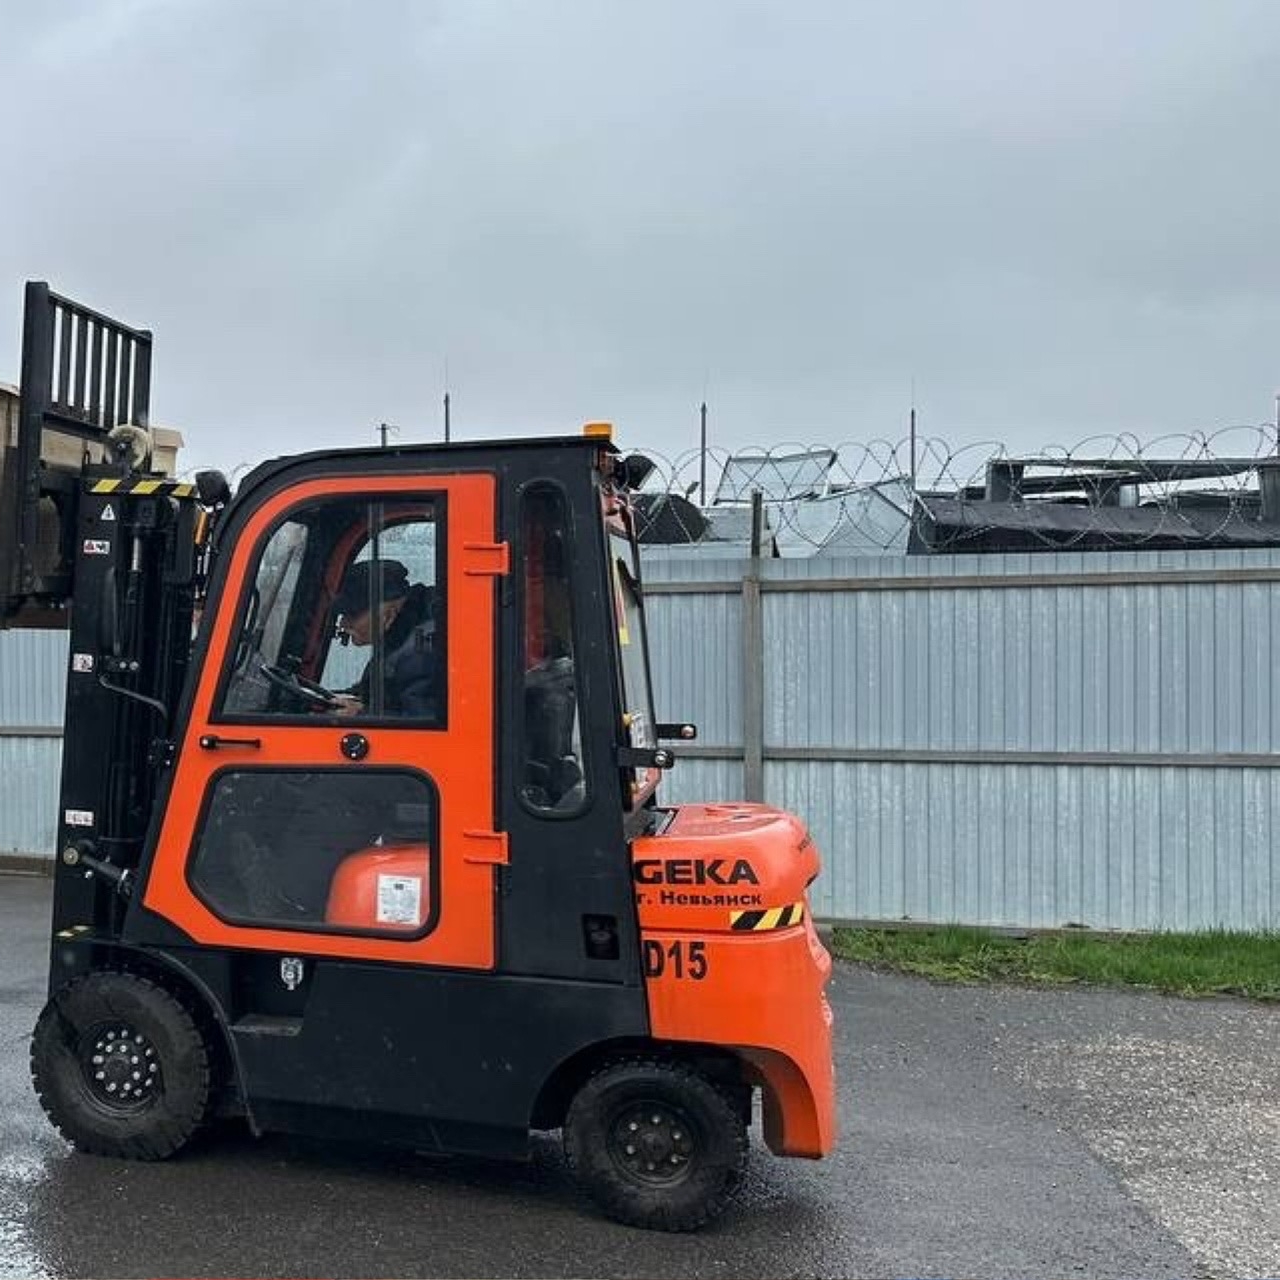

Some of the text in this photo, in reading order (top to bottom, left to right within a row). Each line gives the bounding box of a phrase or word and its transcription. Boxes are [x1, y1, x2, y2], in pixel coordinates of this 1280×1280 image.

[634, 859, 758, 885] GEKA
[660, 891, 761, 905] Невьянск
[644, 939, 708, 980] D15
